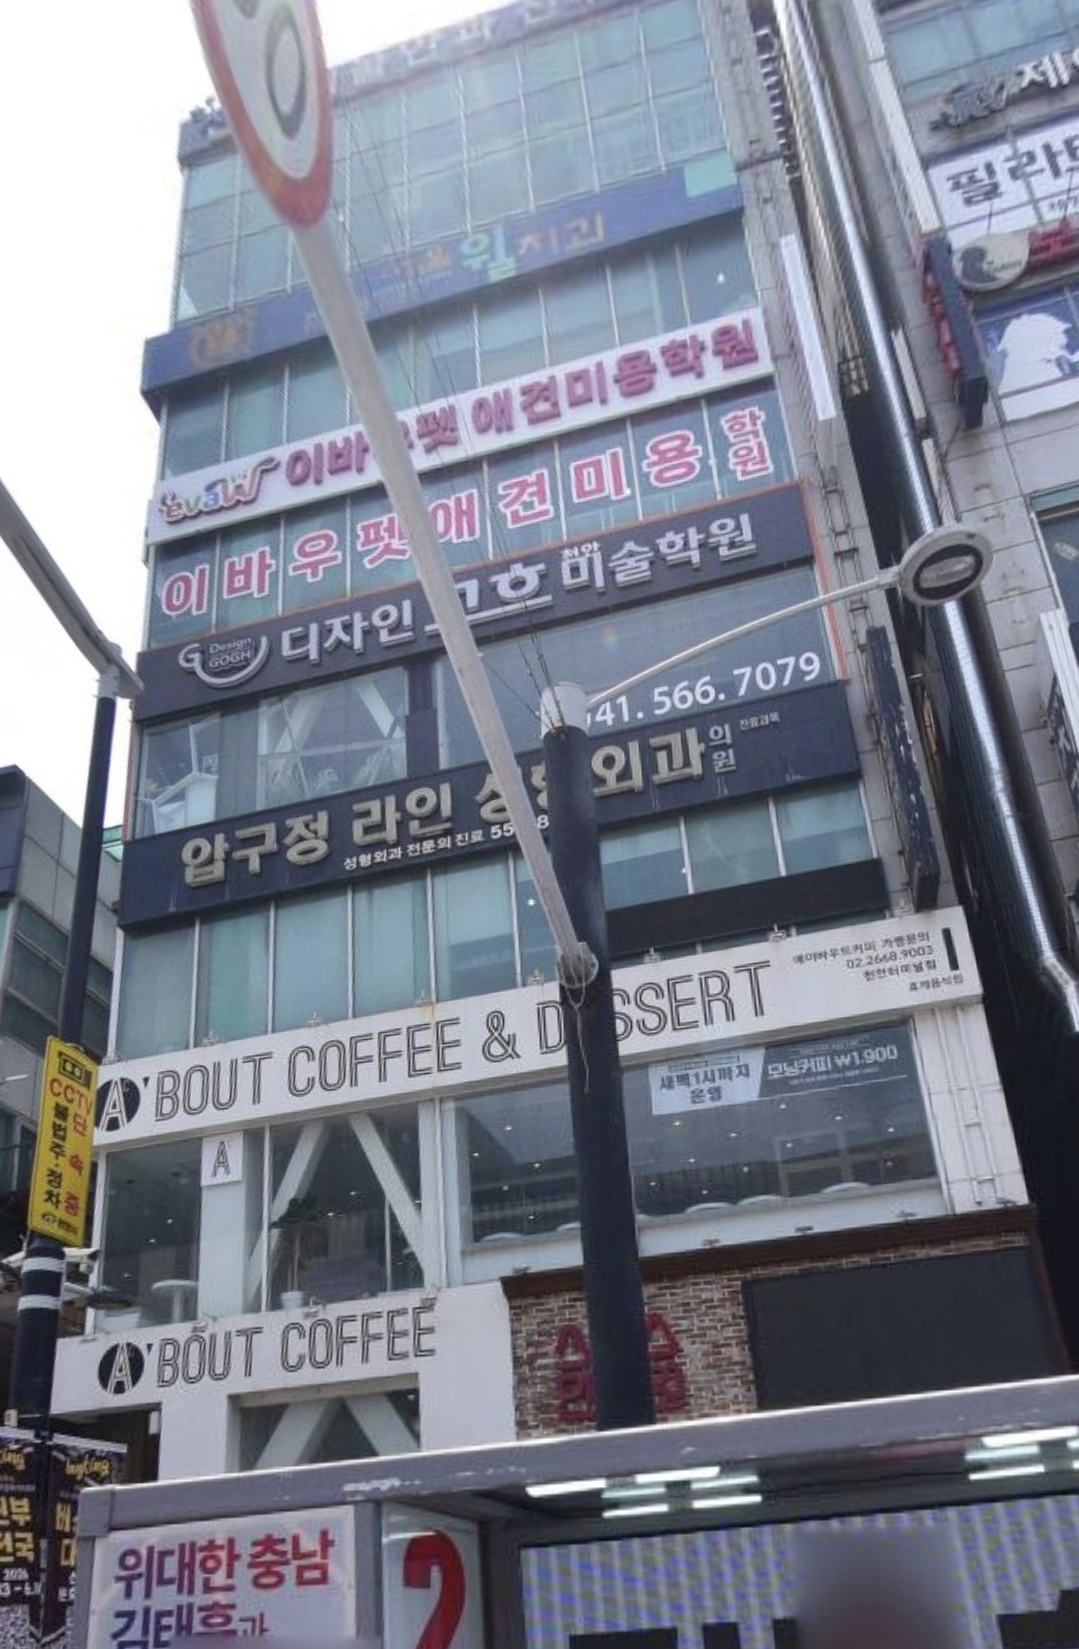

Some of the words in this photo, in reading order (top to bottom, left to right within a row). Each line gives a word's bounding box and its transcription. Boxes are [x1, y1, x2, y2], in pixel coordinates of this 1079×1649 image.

[719, 406, 775, 482] 학원
[281, 599, 416, 664] 디자인
[561, 512, 757, 592] 미술학원
[586, 651, 821, 728] 41.566.7079
[181, 810, 331, 888] 압구정
[352, 782, 453, 847] 라인
[343, 847, 403, 872] 성형외과
[407, 835, 452, 856] 전문의
[455, 828, 484, 847] 진료
[287, 1017, 463, 1098] COFFEE
[481, 1010, 521, 1063] &
[536, 960, 771, 1055] DSSERT
[49, 1077, 92, 1116] CCTV
[280, 1305, 438, 1373] COFFEE
[114, 1536, 242, 1600] 위대한
[246, 1528, 335, 1591] 충남
